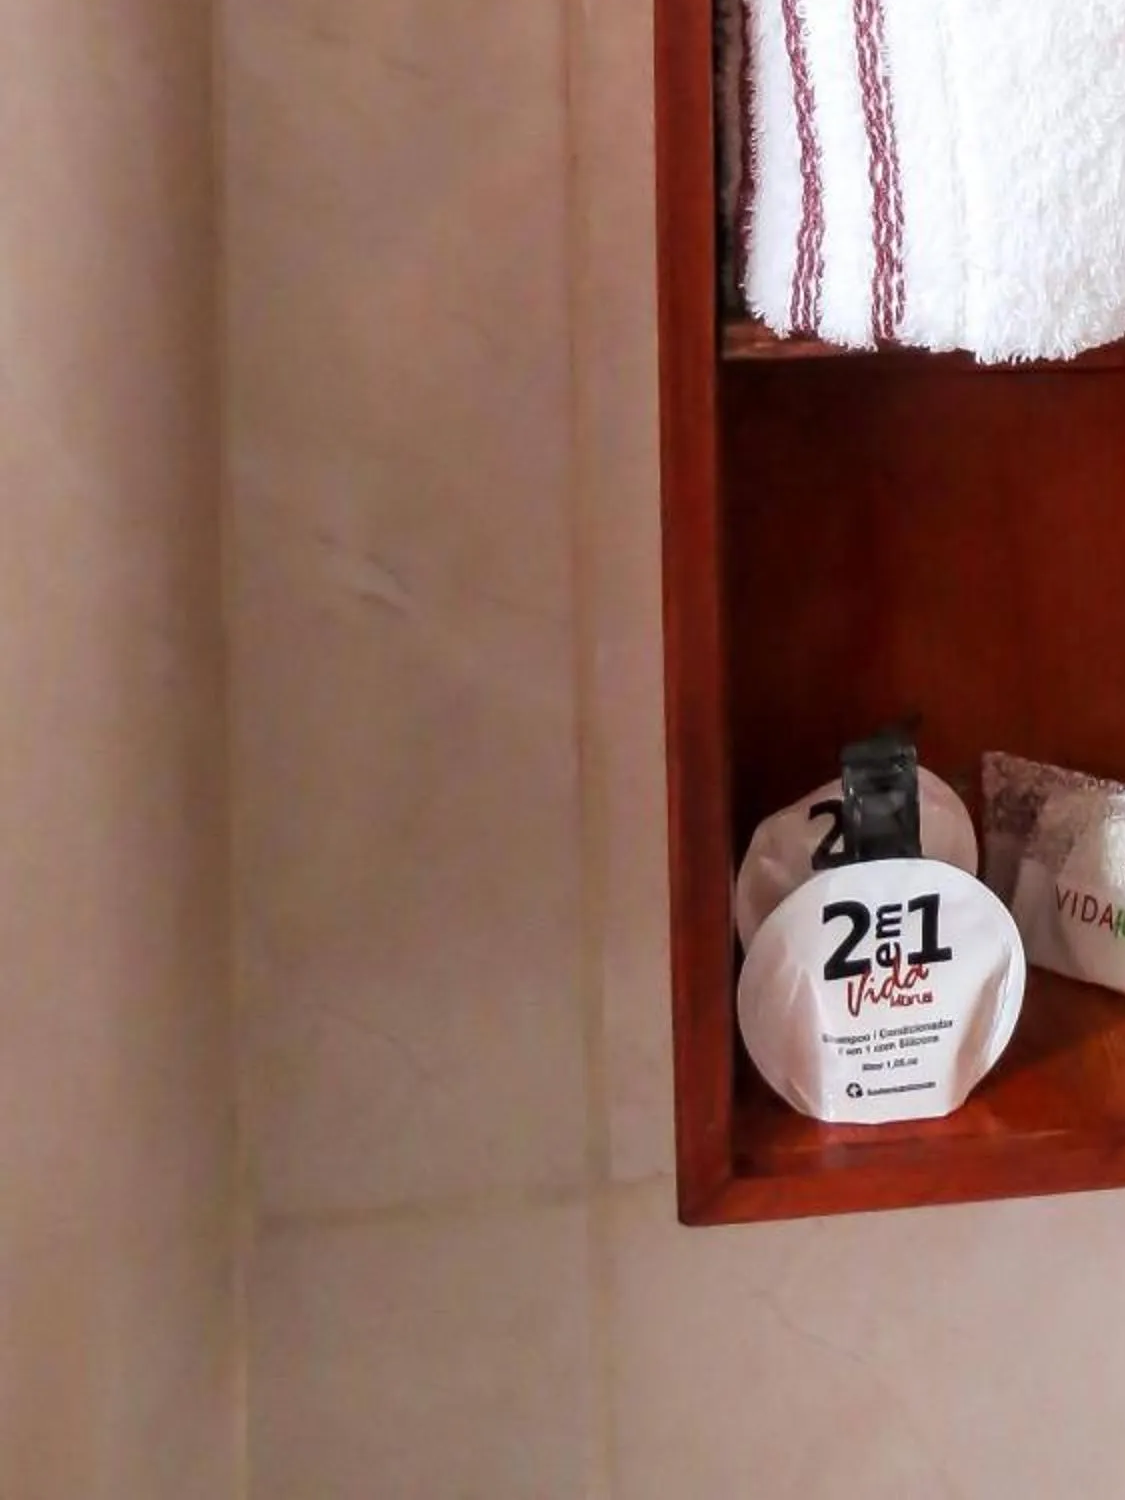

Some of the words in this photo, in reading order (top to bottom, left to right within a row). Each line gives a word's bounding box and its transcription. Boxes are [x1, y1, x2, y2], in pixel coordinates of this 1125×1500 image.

[822, 900, 871, 980] 2
[876, 903, 902, 968] em
[907, 893, 953, 965] 1
[847, 942, 929, 1016] Vida
